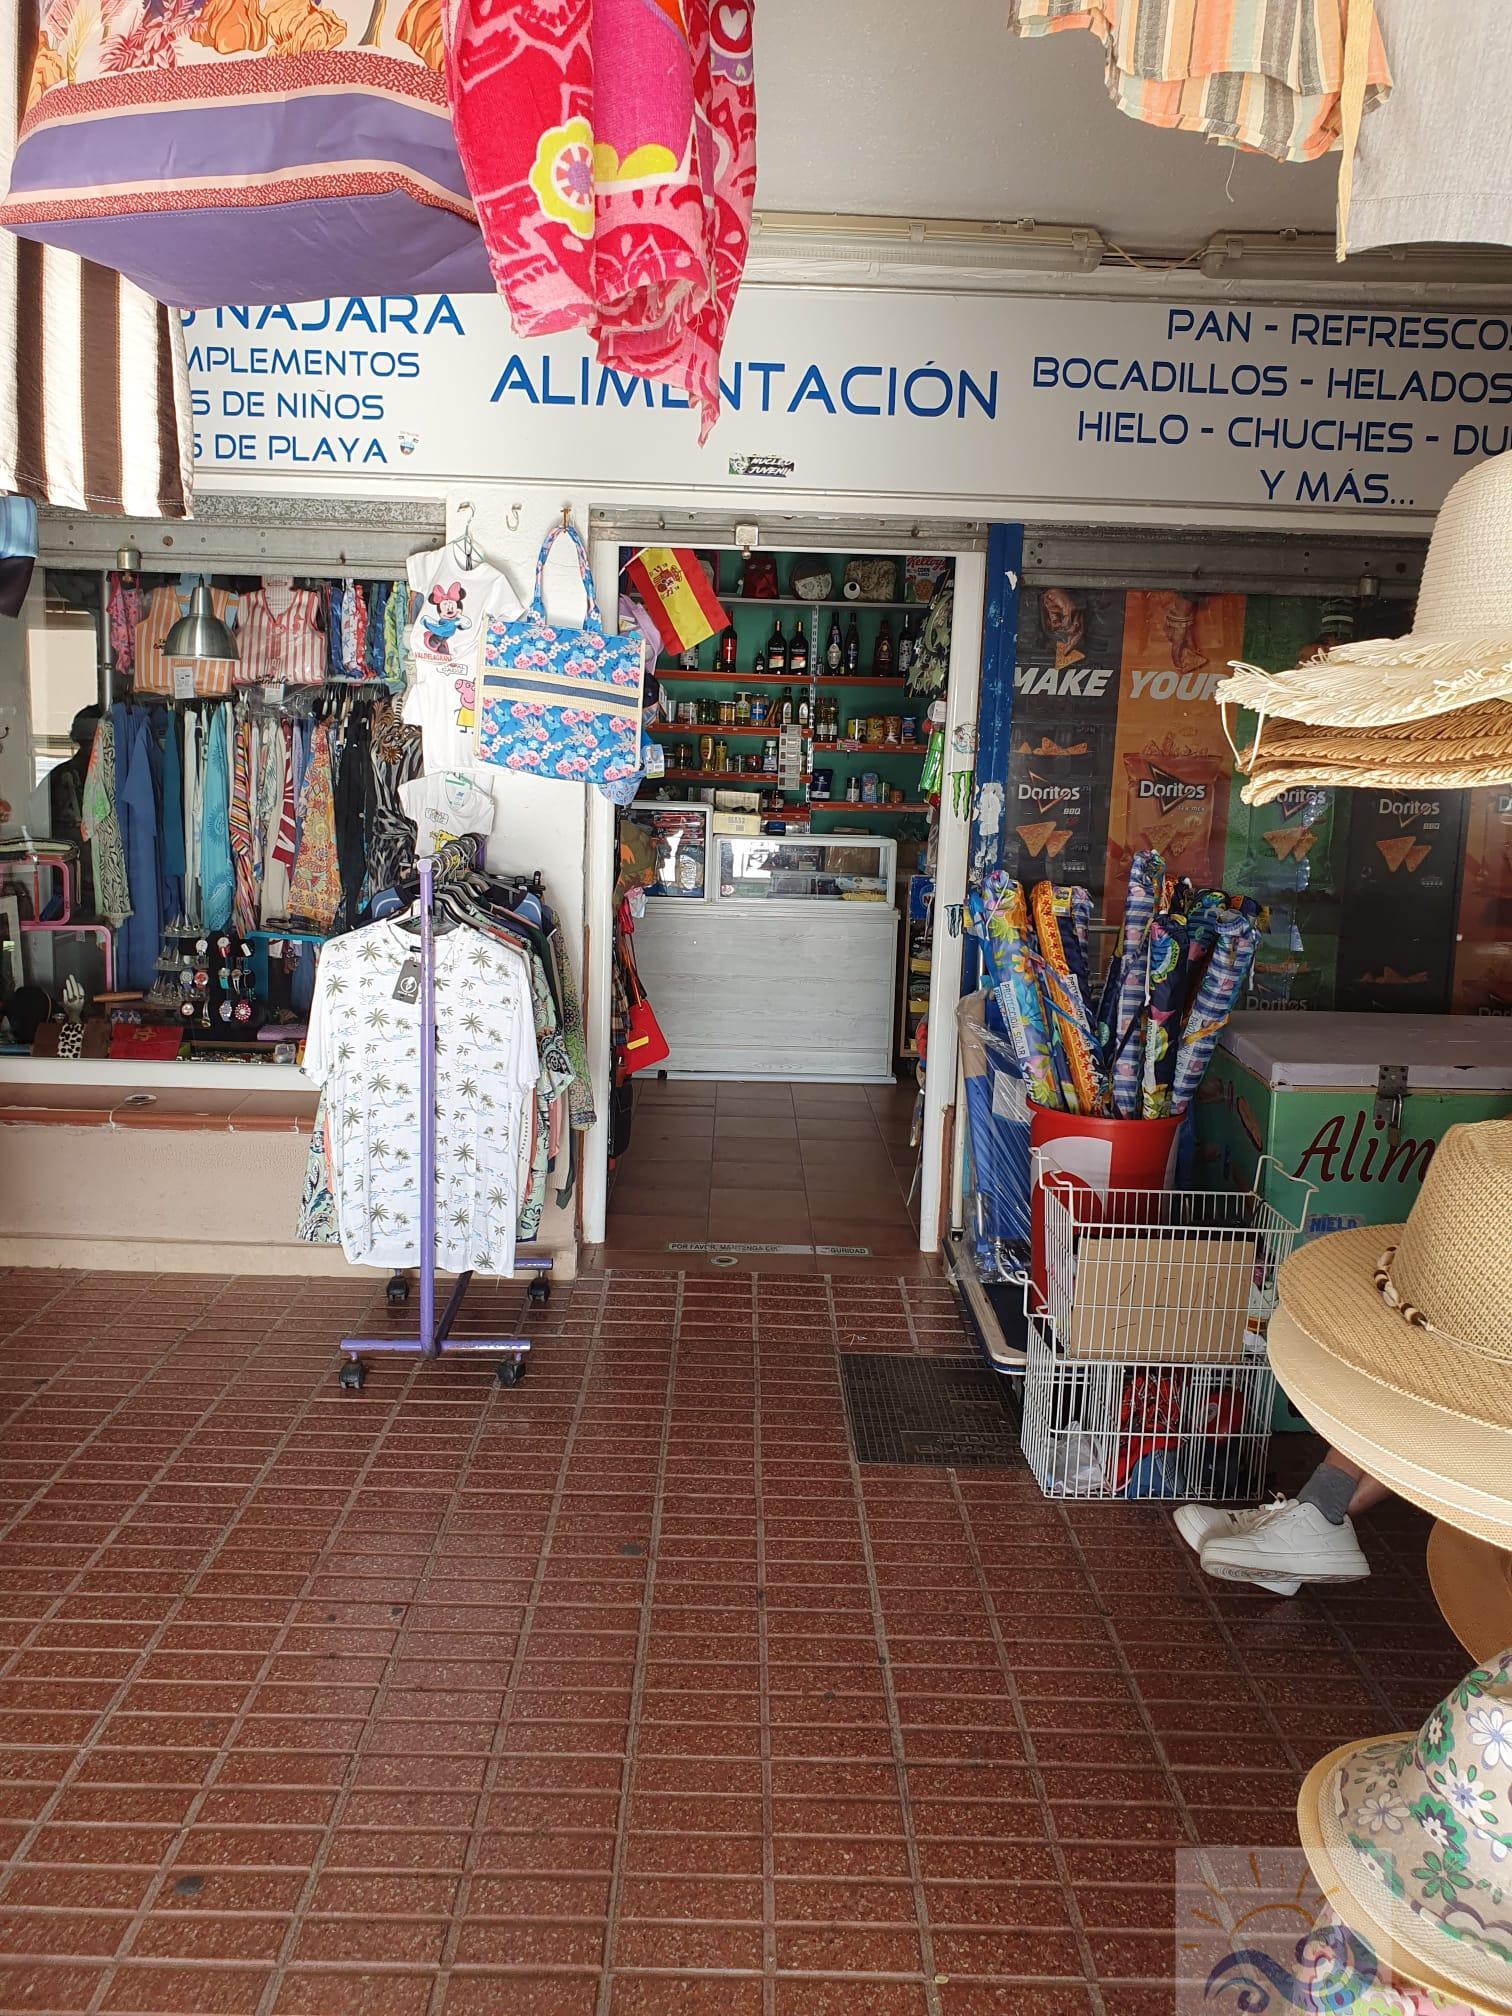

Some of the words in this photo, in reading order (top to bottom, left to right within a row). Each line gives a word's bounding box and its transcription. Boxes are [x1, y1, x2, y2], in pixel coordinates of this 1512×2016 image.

[1167, 309, 1252, 343] PAN
[1291, 313, 1512, 351] REFRESCO
[1033, 356, 1288, 397] BOCADILLOS
[1327, 367, 1512, 404] HELADOS
[223, 391, 265, 418] DE
[277, 389, 385, 420] NIÑOS
[1078, 410, 1189, 445] HIELO
[1228, 416, 1414, 453] CHUCHES
[1453, 424, 1512, 456] DU
[215, 434, 257, 460] DE
[269, 435, 389, 464] PLAYA
[1260, 469, 1286, 500] Y
[1295, 468, 1414, 505] MÁS...
[1014, 666, 1114, 697] MAKE
[1129, 670, 1230, 700] YOUR
[1018, 784, 1081, 801] Doritos
[1139, 780, 1206, 800] Doritos
[1276, 787, 1327, 805] oritos
[1378, 798, 1441, 816] Doritos
